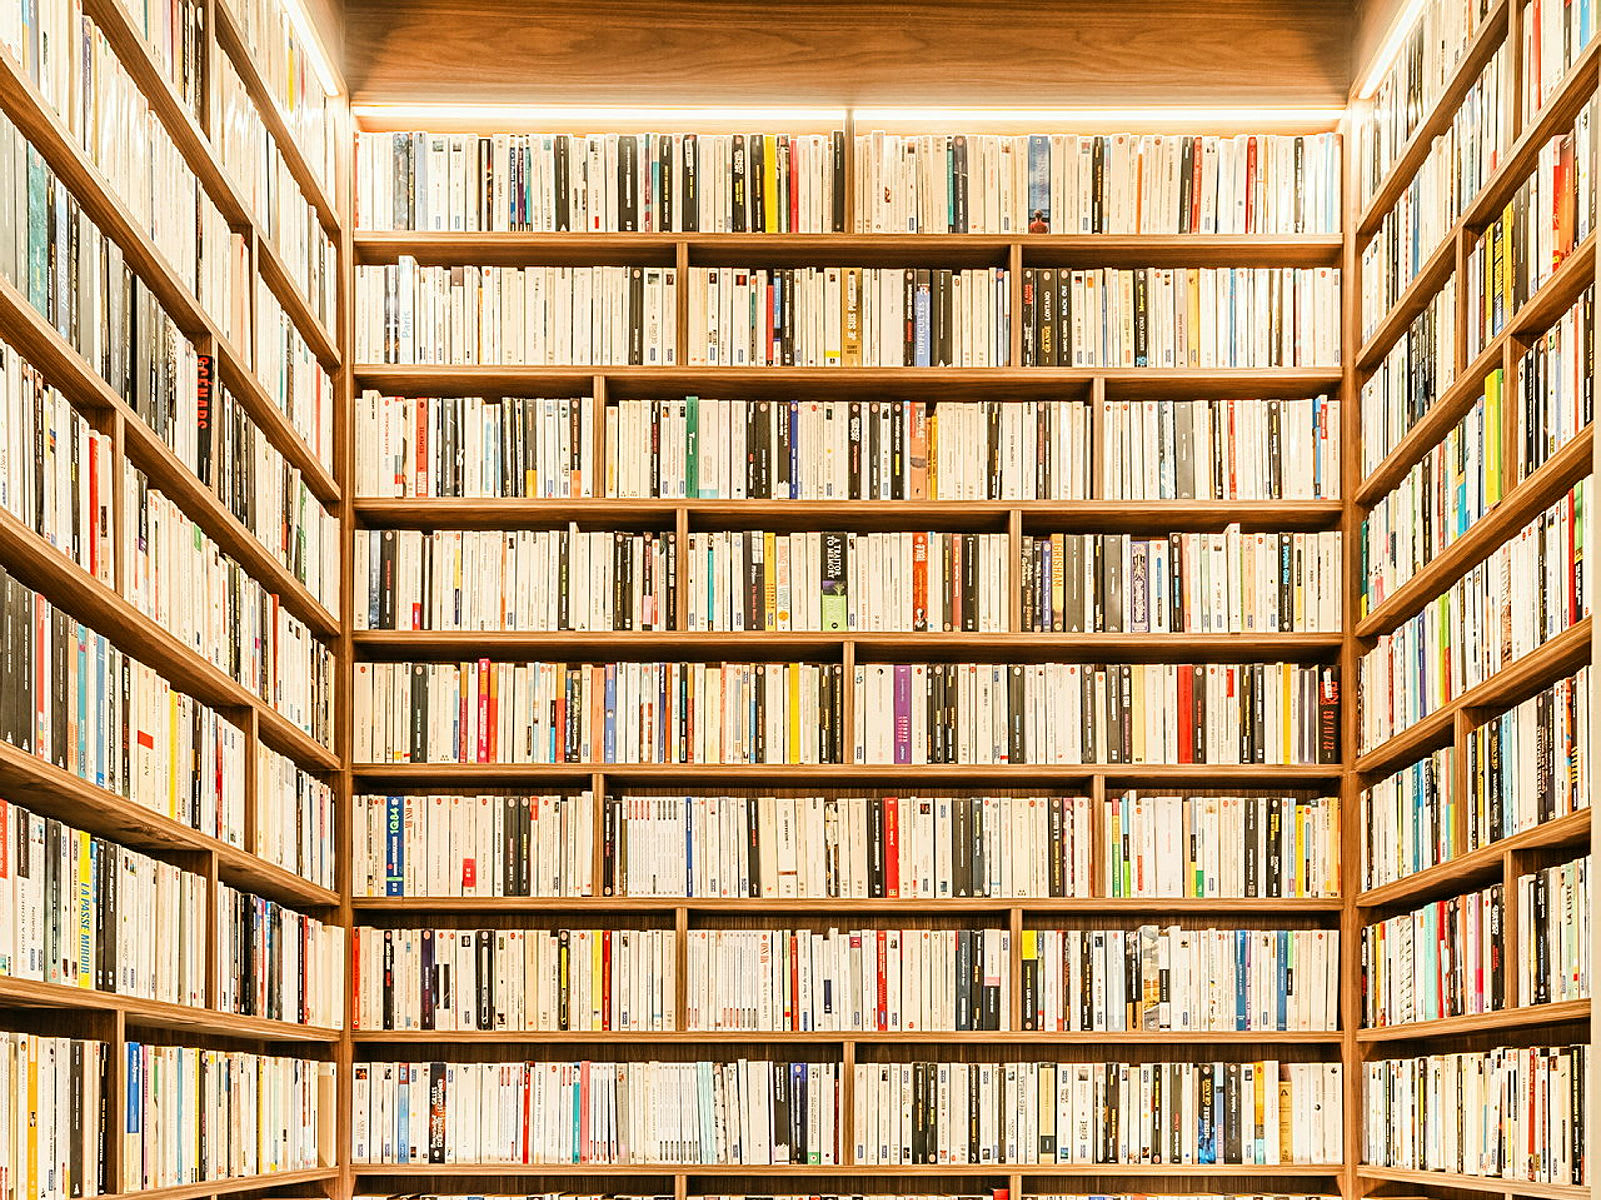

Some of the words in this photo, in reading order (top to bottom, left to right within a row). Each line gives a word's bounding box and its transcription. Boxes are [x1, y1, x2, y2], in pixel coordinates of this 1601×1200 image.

[402, 310, 411, 338] Paris
[848, 330, 857, 340] JE
[827, 536, 834, 546] TO
[1053, 544, 1064, 587] GRISHAM
[389, 808, 400, 834] 1Q84
[81, 882, 90, 898] LA
[1565, 883, 1573, 910] LISTE
[1566, 912, 1573, 926] LA
